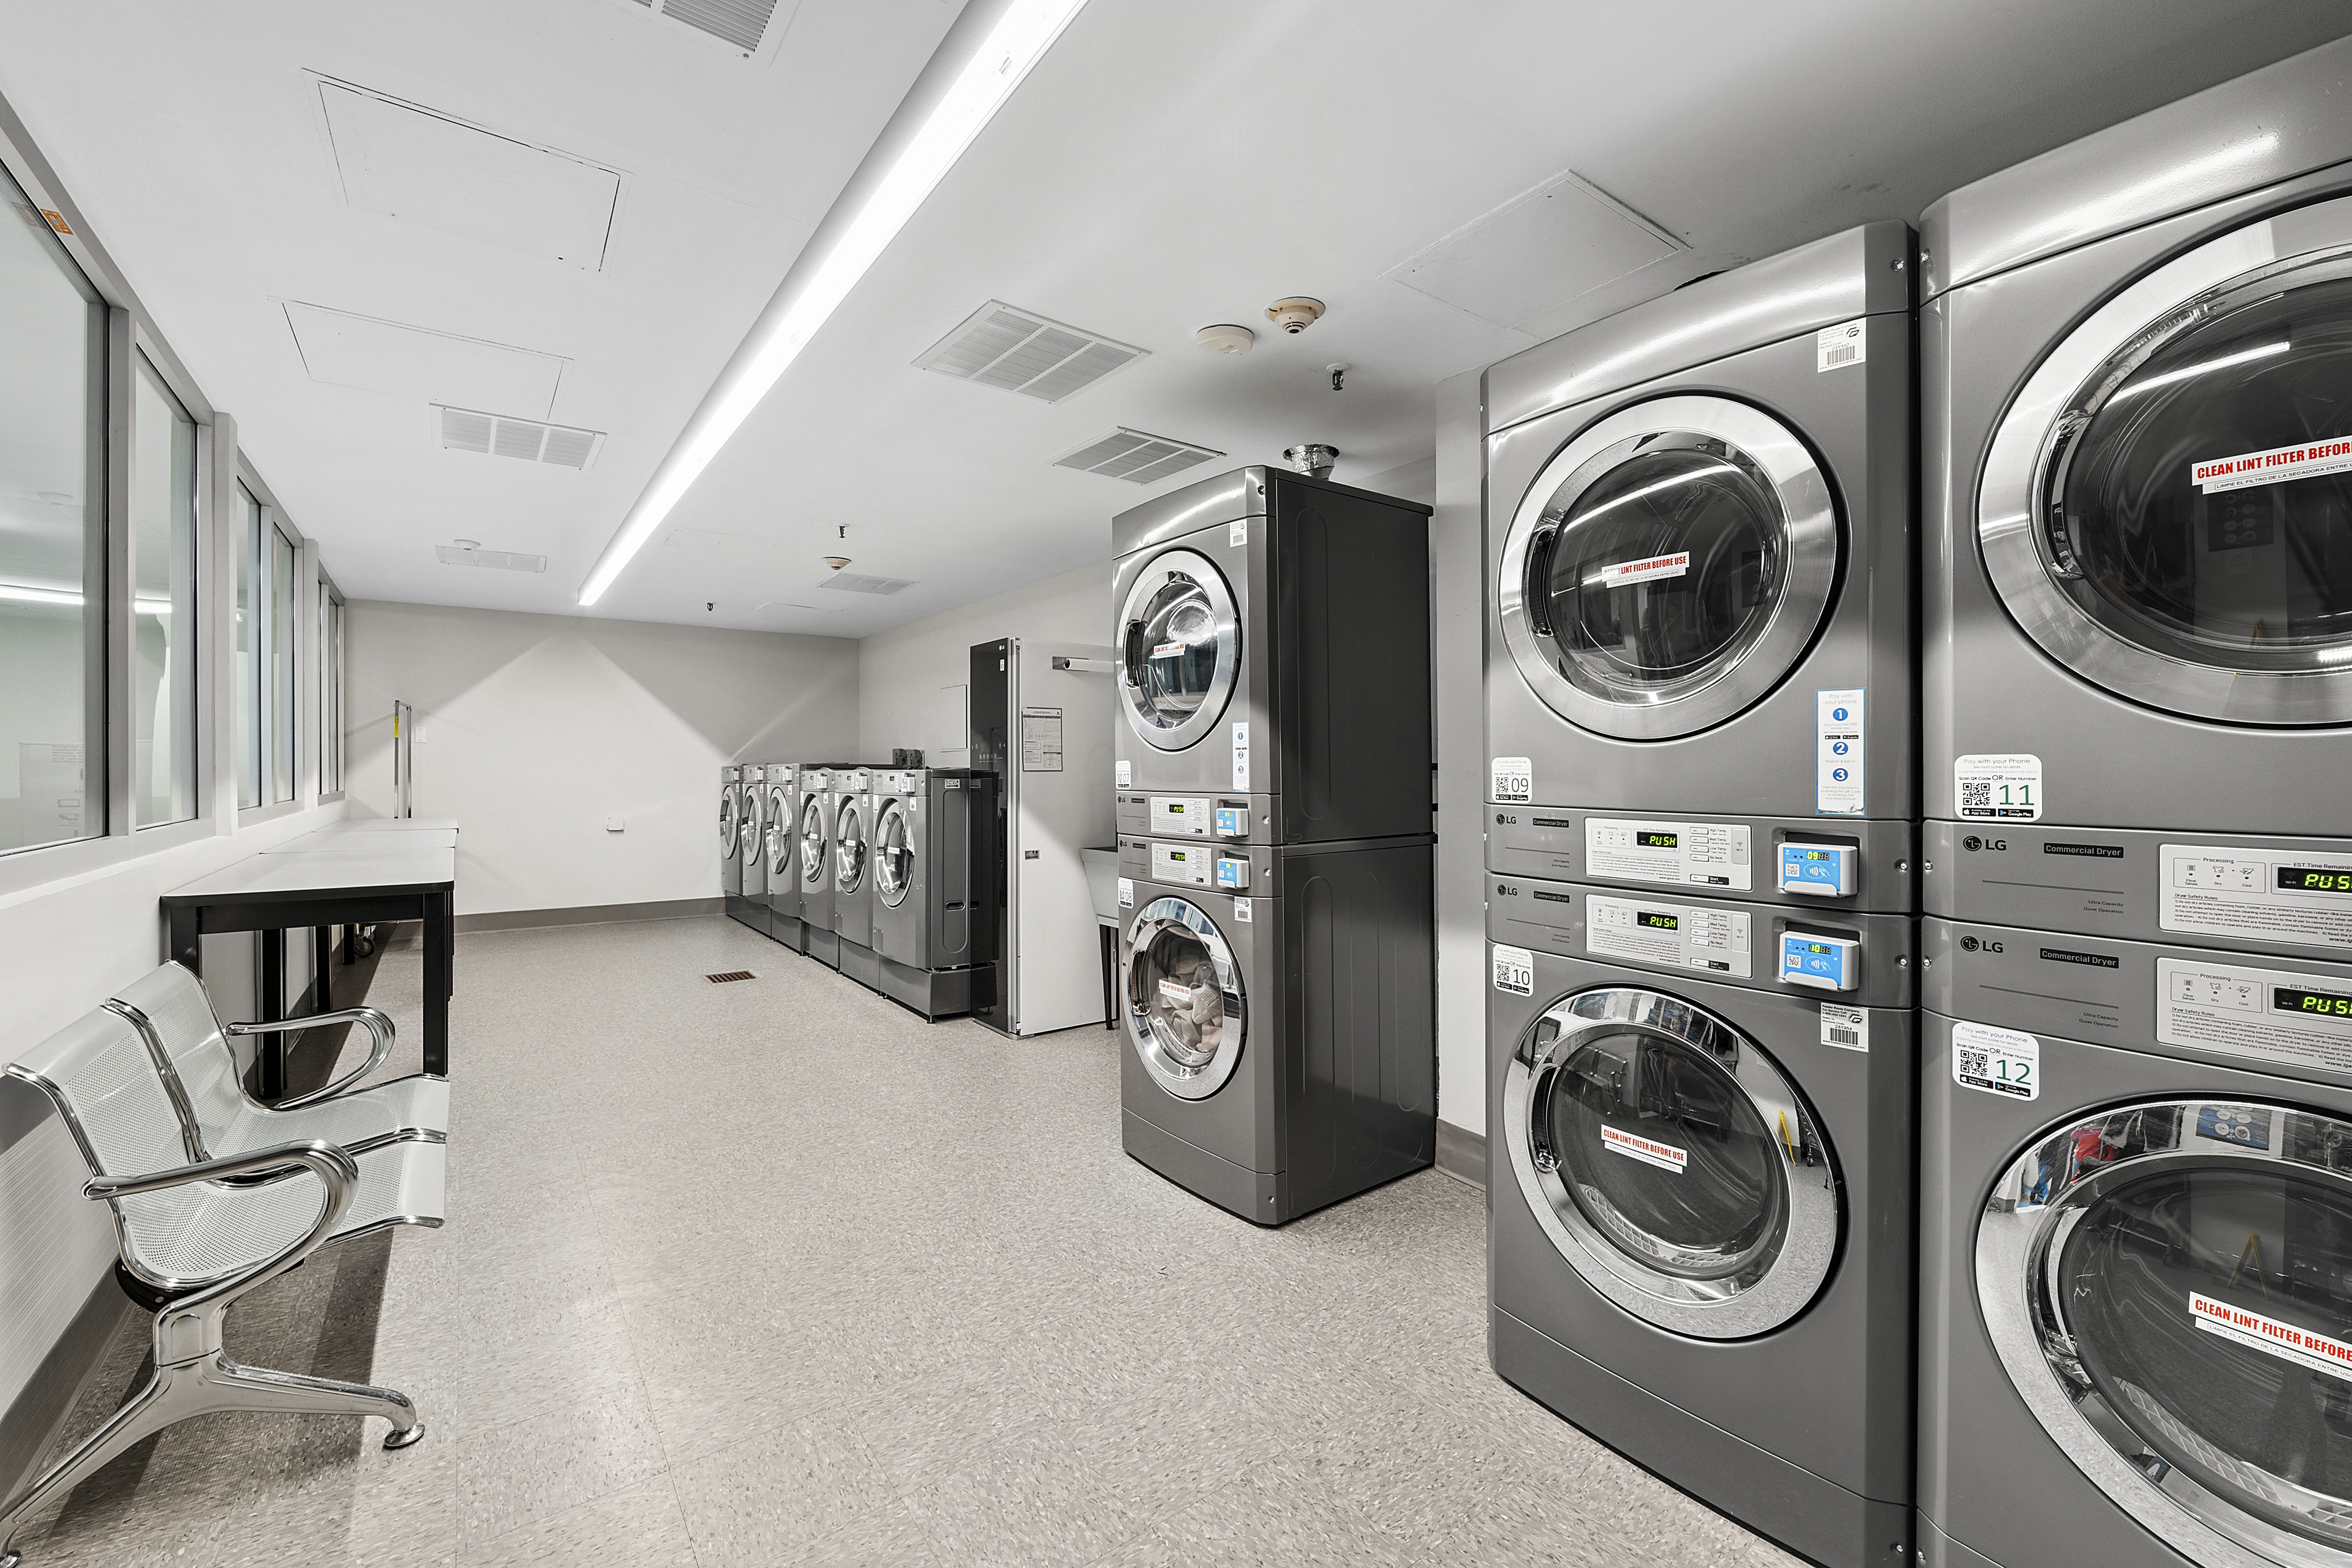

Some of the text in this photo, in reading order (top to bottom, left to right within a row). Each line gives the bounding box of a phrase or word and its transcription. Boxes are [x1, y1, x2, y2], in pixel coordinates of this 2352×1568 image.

[2197, 441, 2352, 479] CLEAN LINT FILTER BEFOR
[2289, 468, 2325, 477] SECADORA
[1621, 566, 1632, 574] LINT
[1633, 562, 1650, 572] FILTER
[1652, 558, 1673, 568] BEFORE
[1675, 556, 1686, 564] USE
[1838, 709, 1842, 719] 1
[1836, 743, 1845, 753] 2
[1123, 774, 1129, 783] 07
[1836, 769, 1845, 780] 3
[1512, 778, 1528, 792] 09
[1999, 784, 2035, 806] 11
[1649, 835, 1676, 845] PUSH
[1986, 839, 2007, 851] LG
[2045, 845, 2094, 855] Commercial
[2305, 874, 2352, 889] PUS
[1125, 892, 1132, 901] 08
[1508, 887, 1517, 896] LG
[1650, 916, 1676, 927] PUSH
[1983, 940, 2003, 953] LG
[2042, 950, 2117, 966] Commercial Dryer
[1513, 969, 1530, 985] 10
[2200, 973, 2231, 981] Processing
[2303, 997, 2352, 1014] PUS
[2006, 1034, 2028, 1043] Phone
[1996, 1059, 2031, 1086] 12
[1604, 1129, 1619, 1140] CLEAN
[1620, 1134, 1631, 1144] LINT
[1633, 1138, 1649, 1150] FILTER
[1650, 1144, 1672, 1157] BEFORE
[1673, 1151, 1684, 1161] USE
[2195, 1299, 2352, 1362] CLEAN LINT FILTER BEFORE
[2210, 1325, 2228, 1336] LIMPIE
[2238, 1334, 2259, 1346] FILTRO
[2280, 1350, 2316, 1365] SECADORA
[2317, 1363, 2339, 1373] ENTRE
